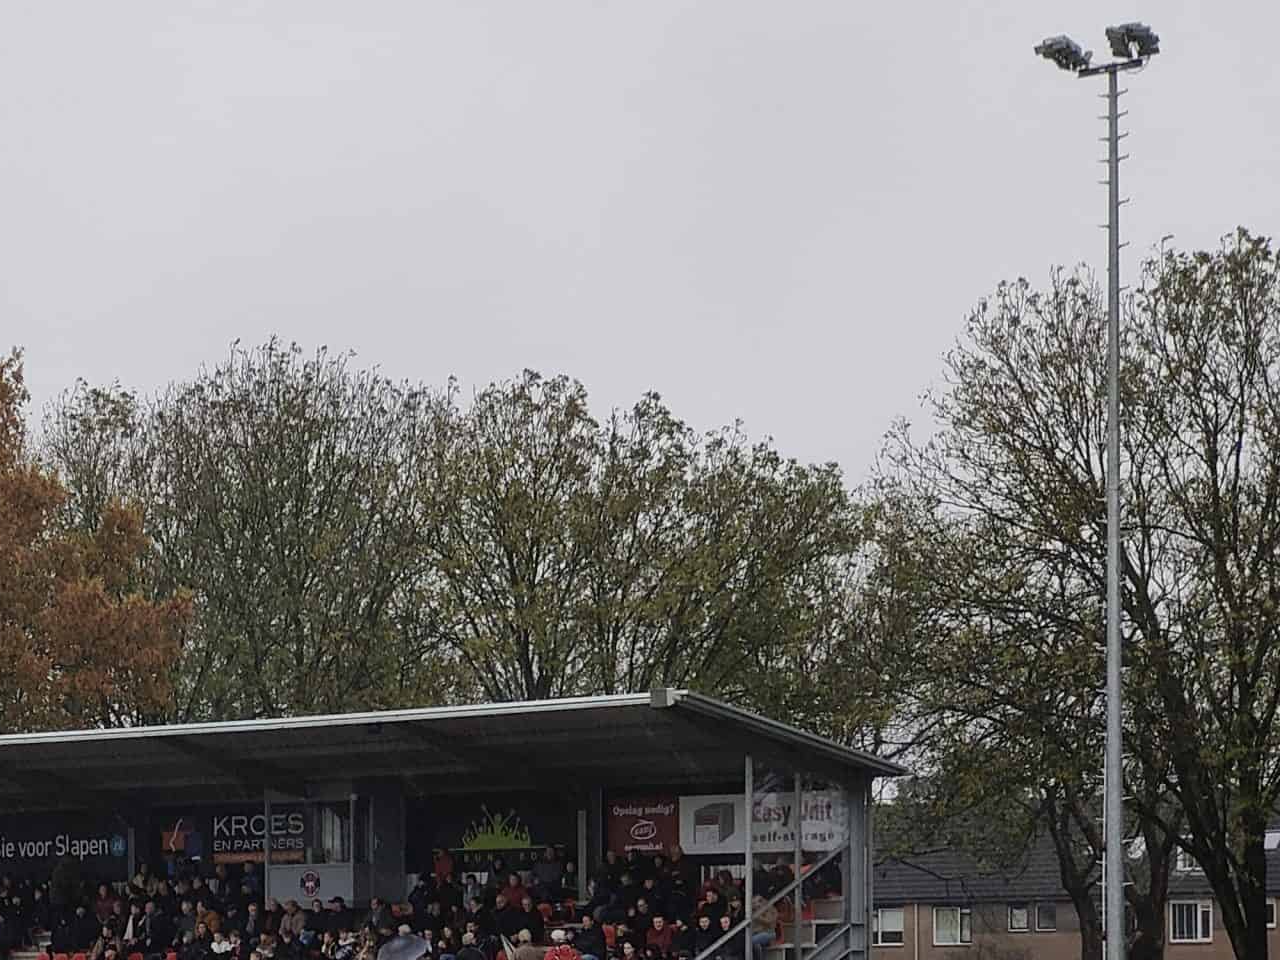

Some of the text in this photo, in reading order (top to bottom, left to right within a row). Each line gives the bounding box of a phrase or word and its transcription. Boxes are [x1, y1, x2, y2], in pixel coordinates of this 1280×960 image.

[213, 814, 304, 837] KROES
[214, 840, 231, 851] EN
[752, 832, 834, 843] self-strage
[18, 841, 52, 857] voor
[55, 834, 108, 860] Slapen
